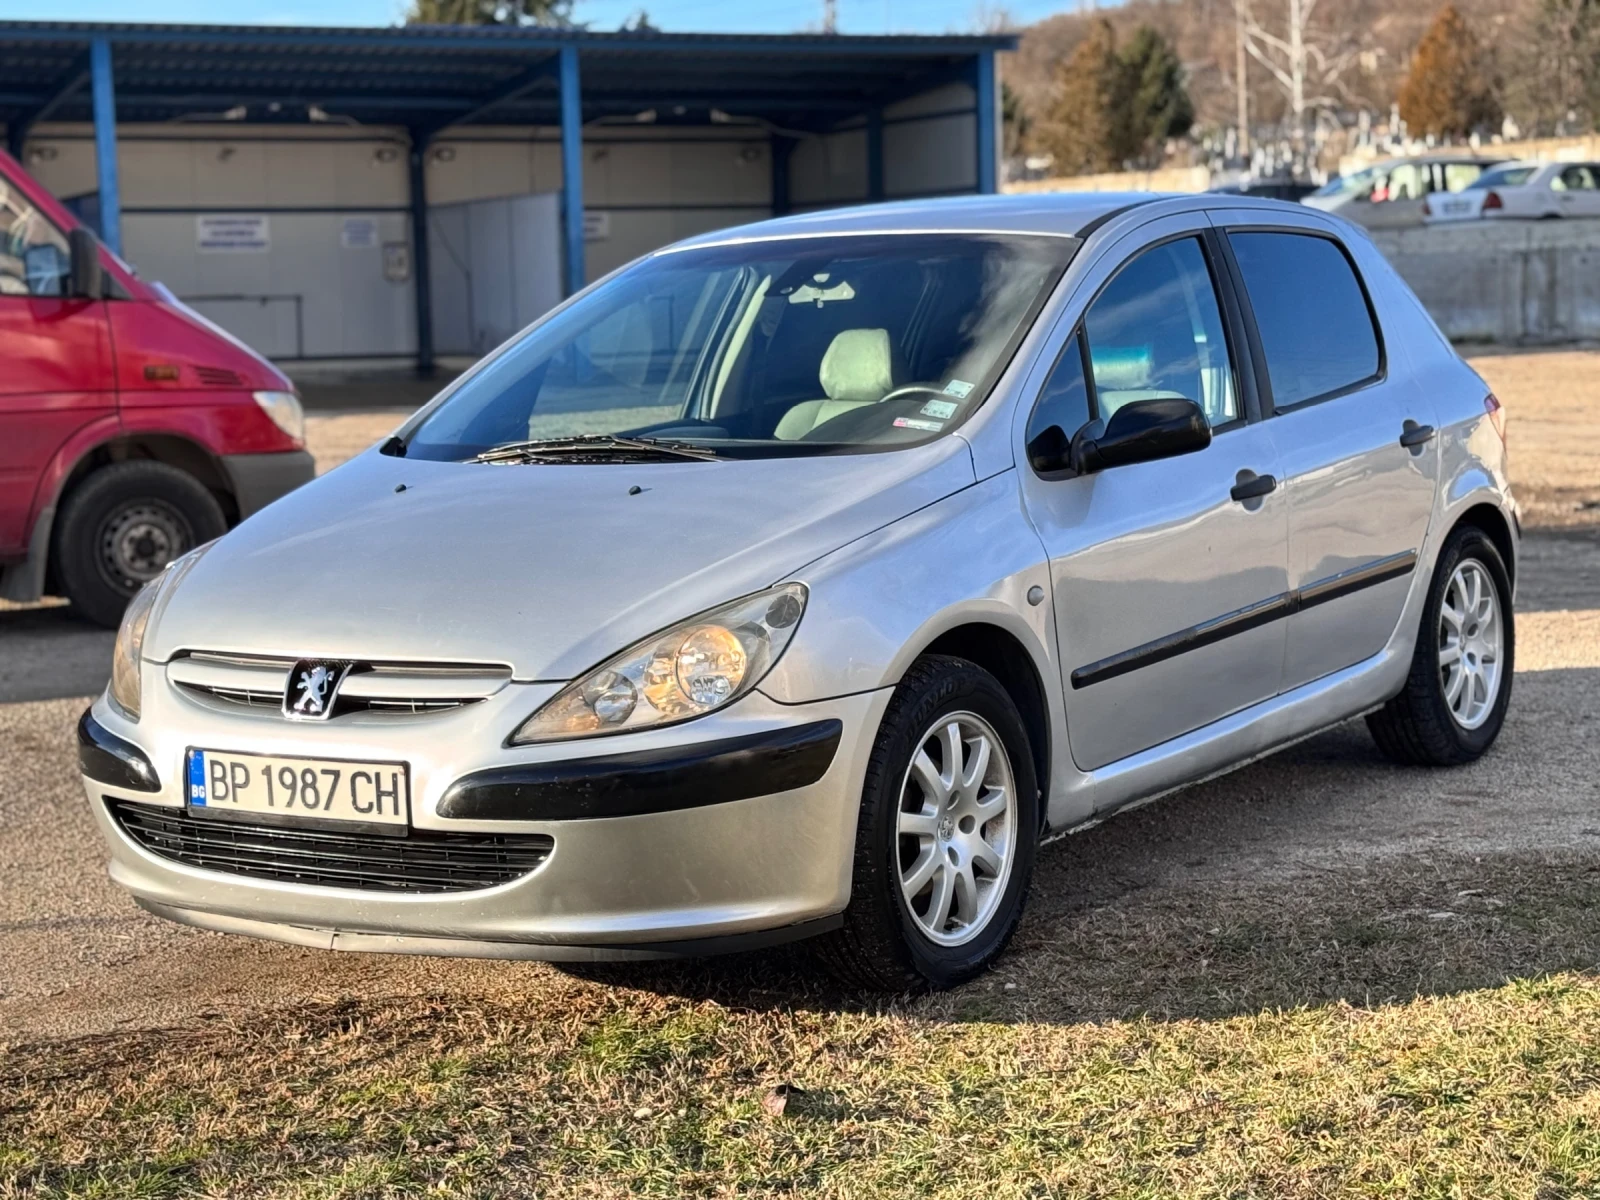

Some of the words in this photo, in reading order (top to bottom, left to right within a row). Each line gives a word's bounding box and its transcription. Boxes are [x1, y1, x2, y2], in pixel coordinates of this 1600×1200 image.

[191, 784, 206, 799] BG
[209, 759, 250, 803] BP
[261, 764, 341, 811] 1987
[350, 771, 400, 816] CH
